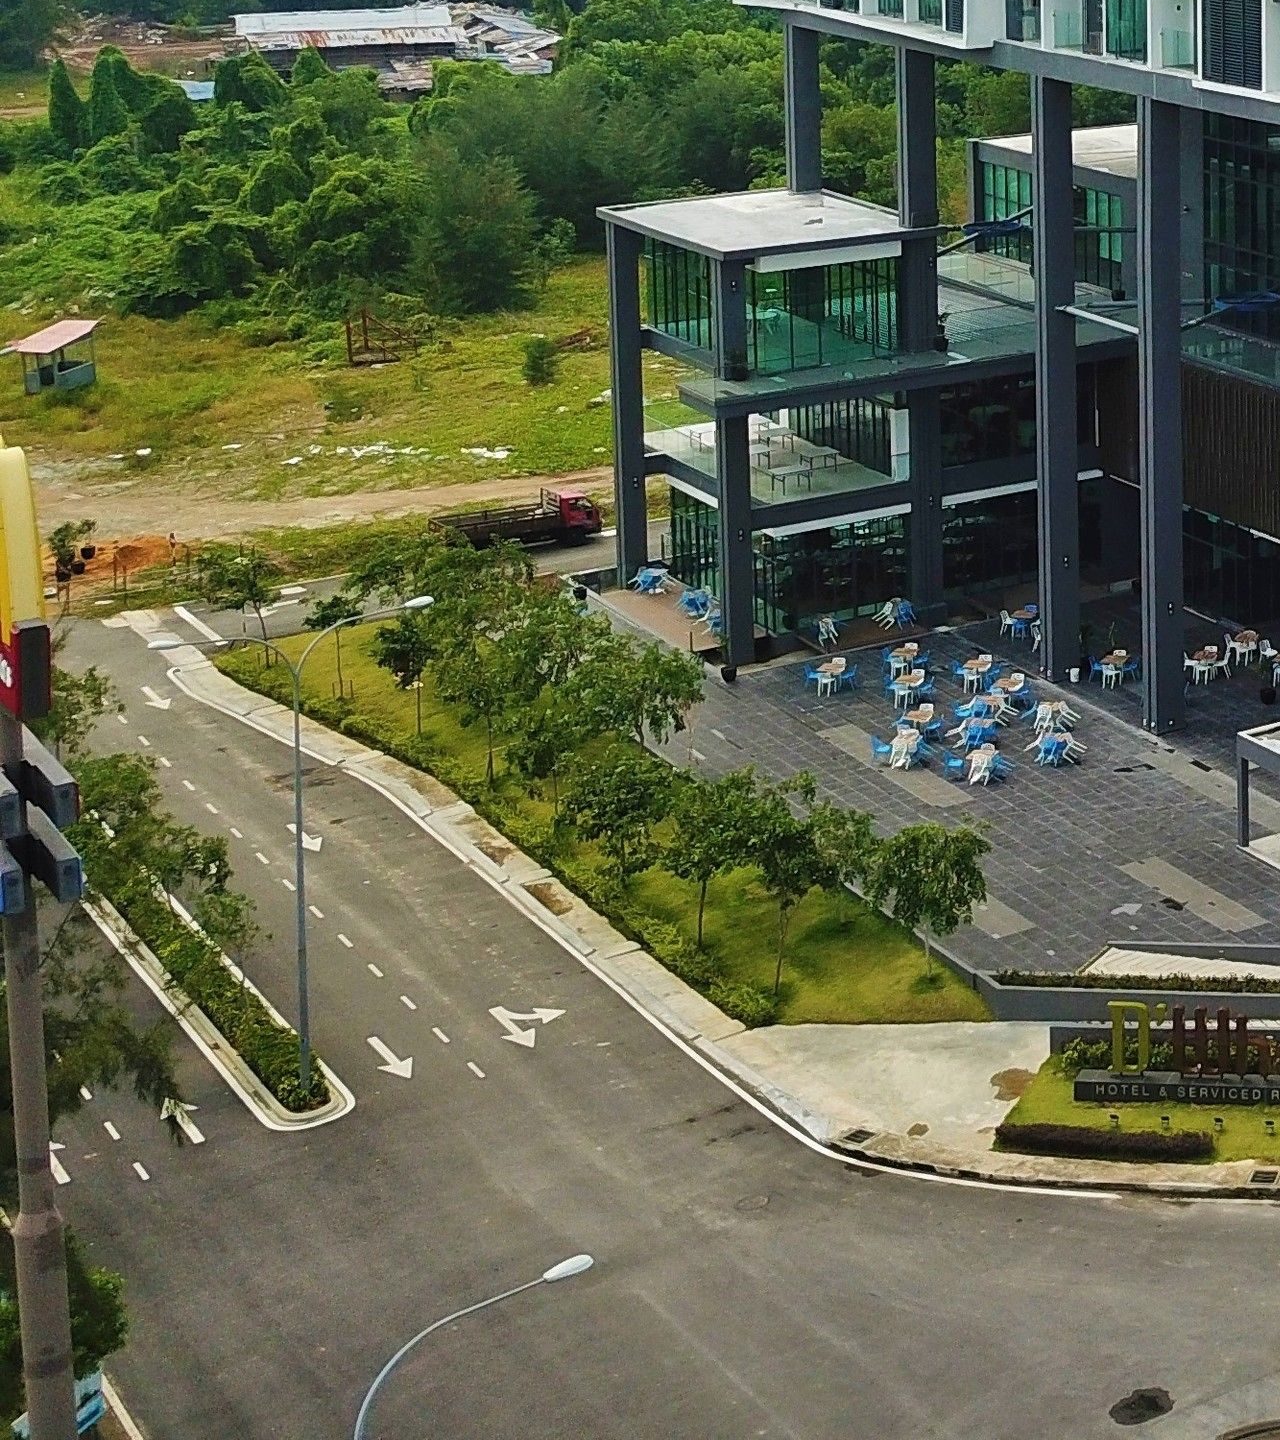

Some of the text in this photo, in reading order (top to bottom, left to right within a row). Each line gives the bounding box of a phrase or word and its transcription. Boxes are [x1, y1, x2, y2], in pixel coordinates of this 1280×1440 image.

[1095, 1084, 1150, 1097] HOTEL
[1159, 1086, 1168, 1097] &
[1177, 1086, 1262, 1100] SERVICED
